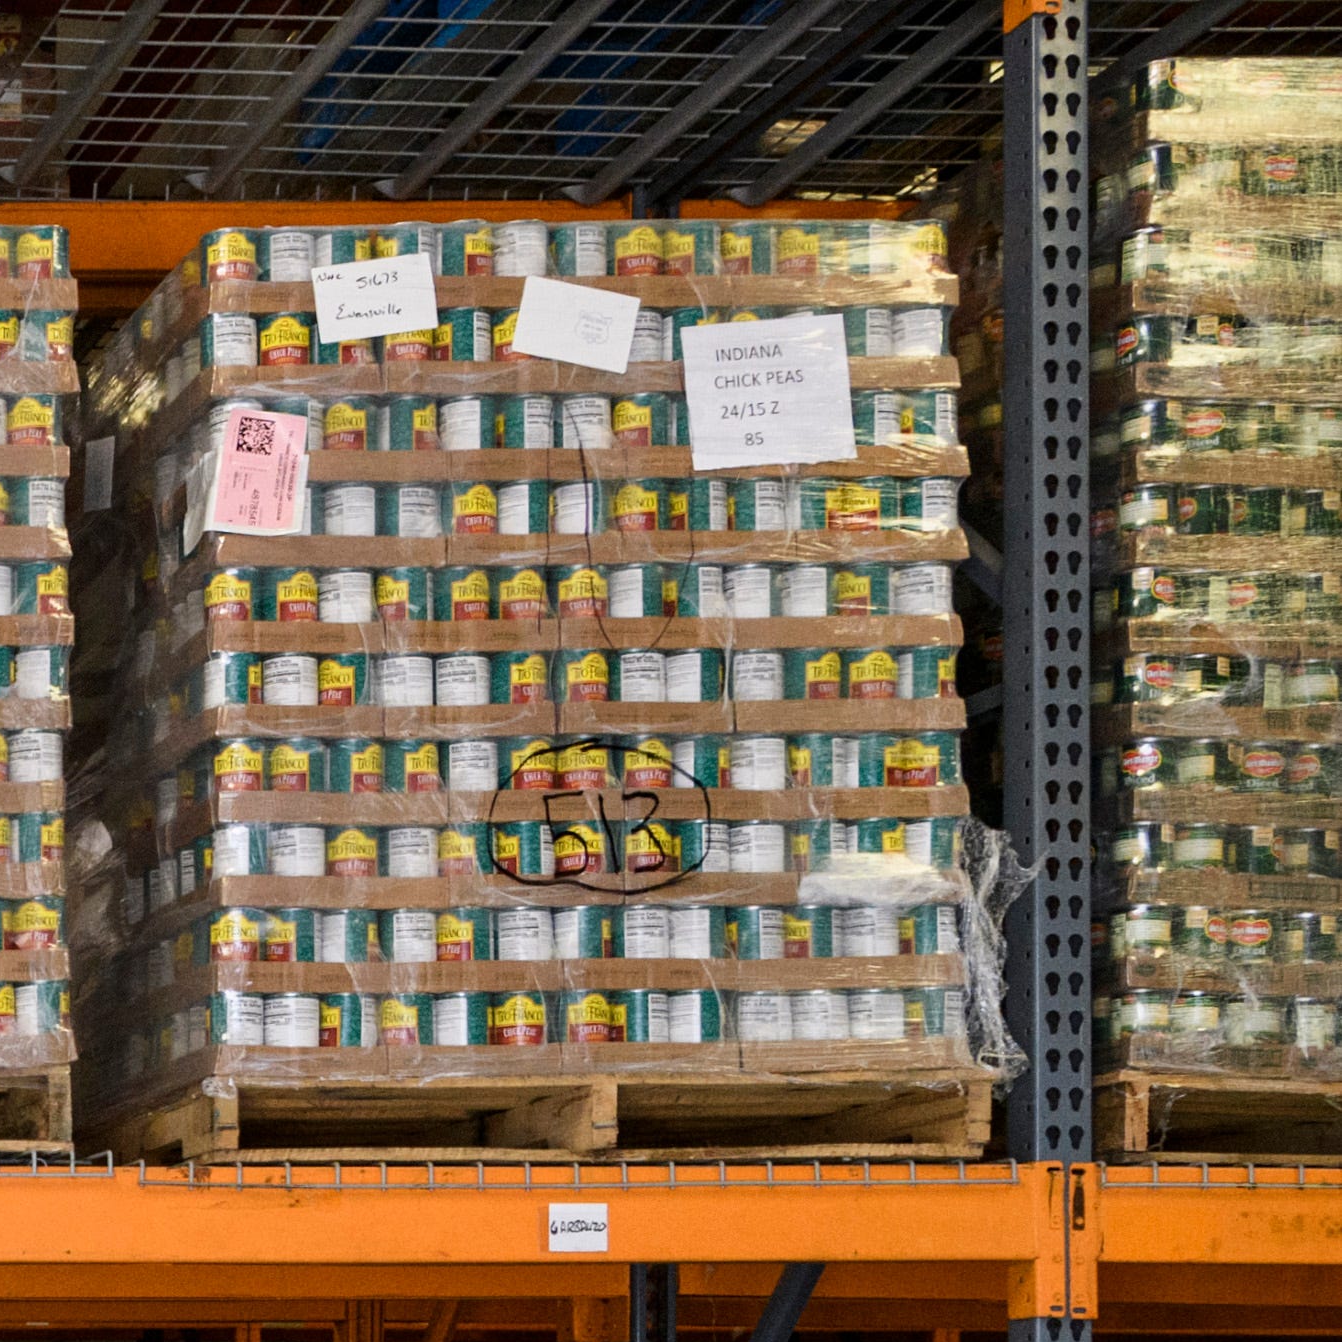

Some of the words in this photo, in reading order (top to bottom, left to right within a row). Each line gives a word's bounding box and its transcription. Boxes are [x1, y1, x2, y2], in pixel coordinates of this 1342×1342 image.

[716, 344, 783, 362] INDIANA
[714, 373, 761, 390] CHICK
[766, 369, 804, 385] PEAS
[721, 402, 766, 420] 24/15
[770, 401, 780, 414] Z
[744, 432, 764, 446] 85
[543, 791, 665, 878] 513
